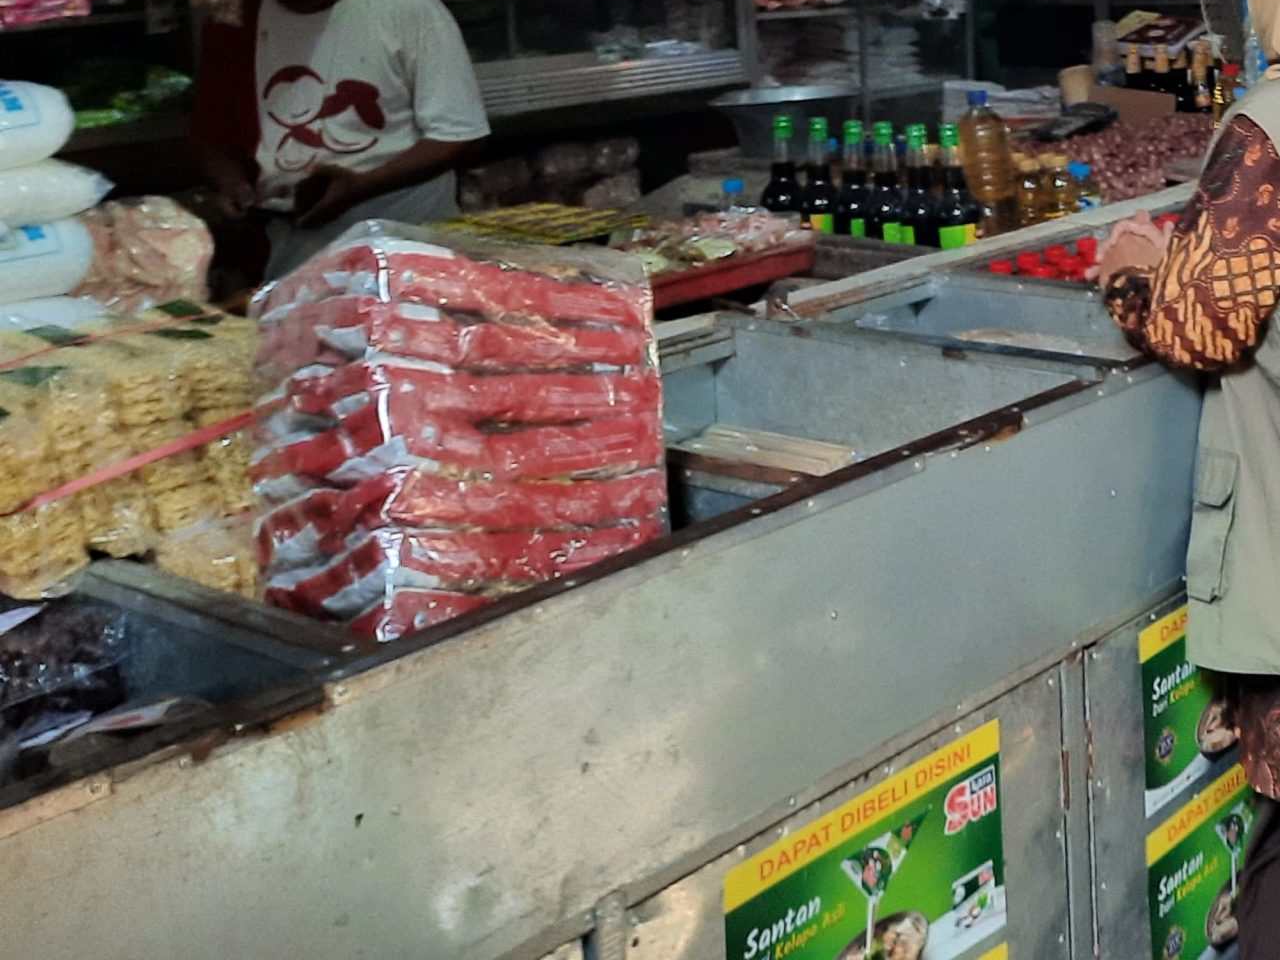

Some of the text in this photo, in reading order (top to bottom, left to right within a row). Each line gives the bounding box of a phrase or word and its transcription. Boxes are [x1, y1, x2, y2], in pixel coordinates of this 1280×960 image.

[760, 743, 971, 881] DAPAT DIBELI DISINI
[1158, 850, 1203, 901] Santan
[743, 895, 821, 960] Santan
